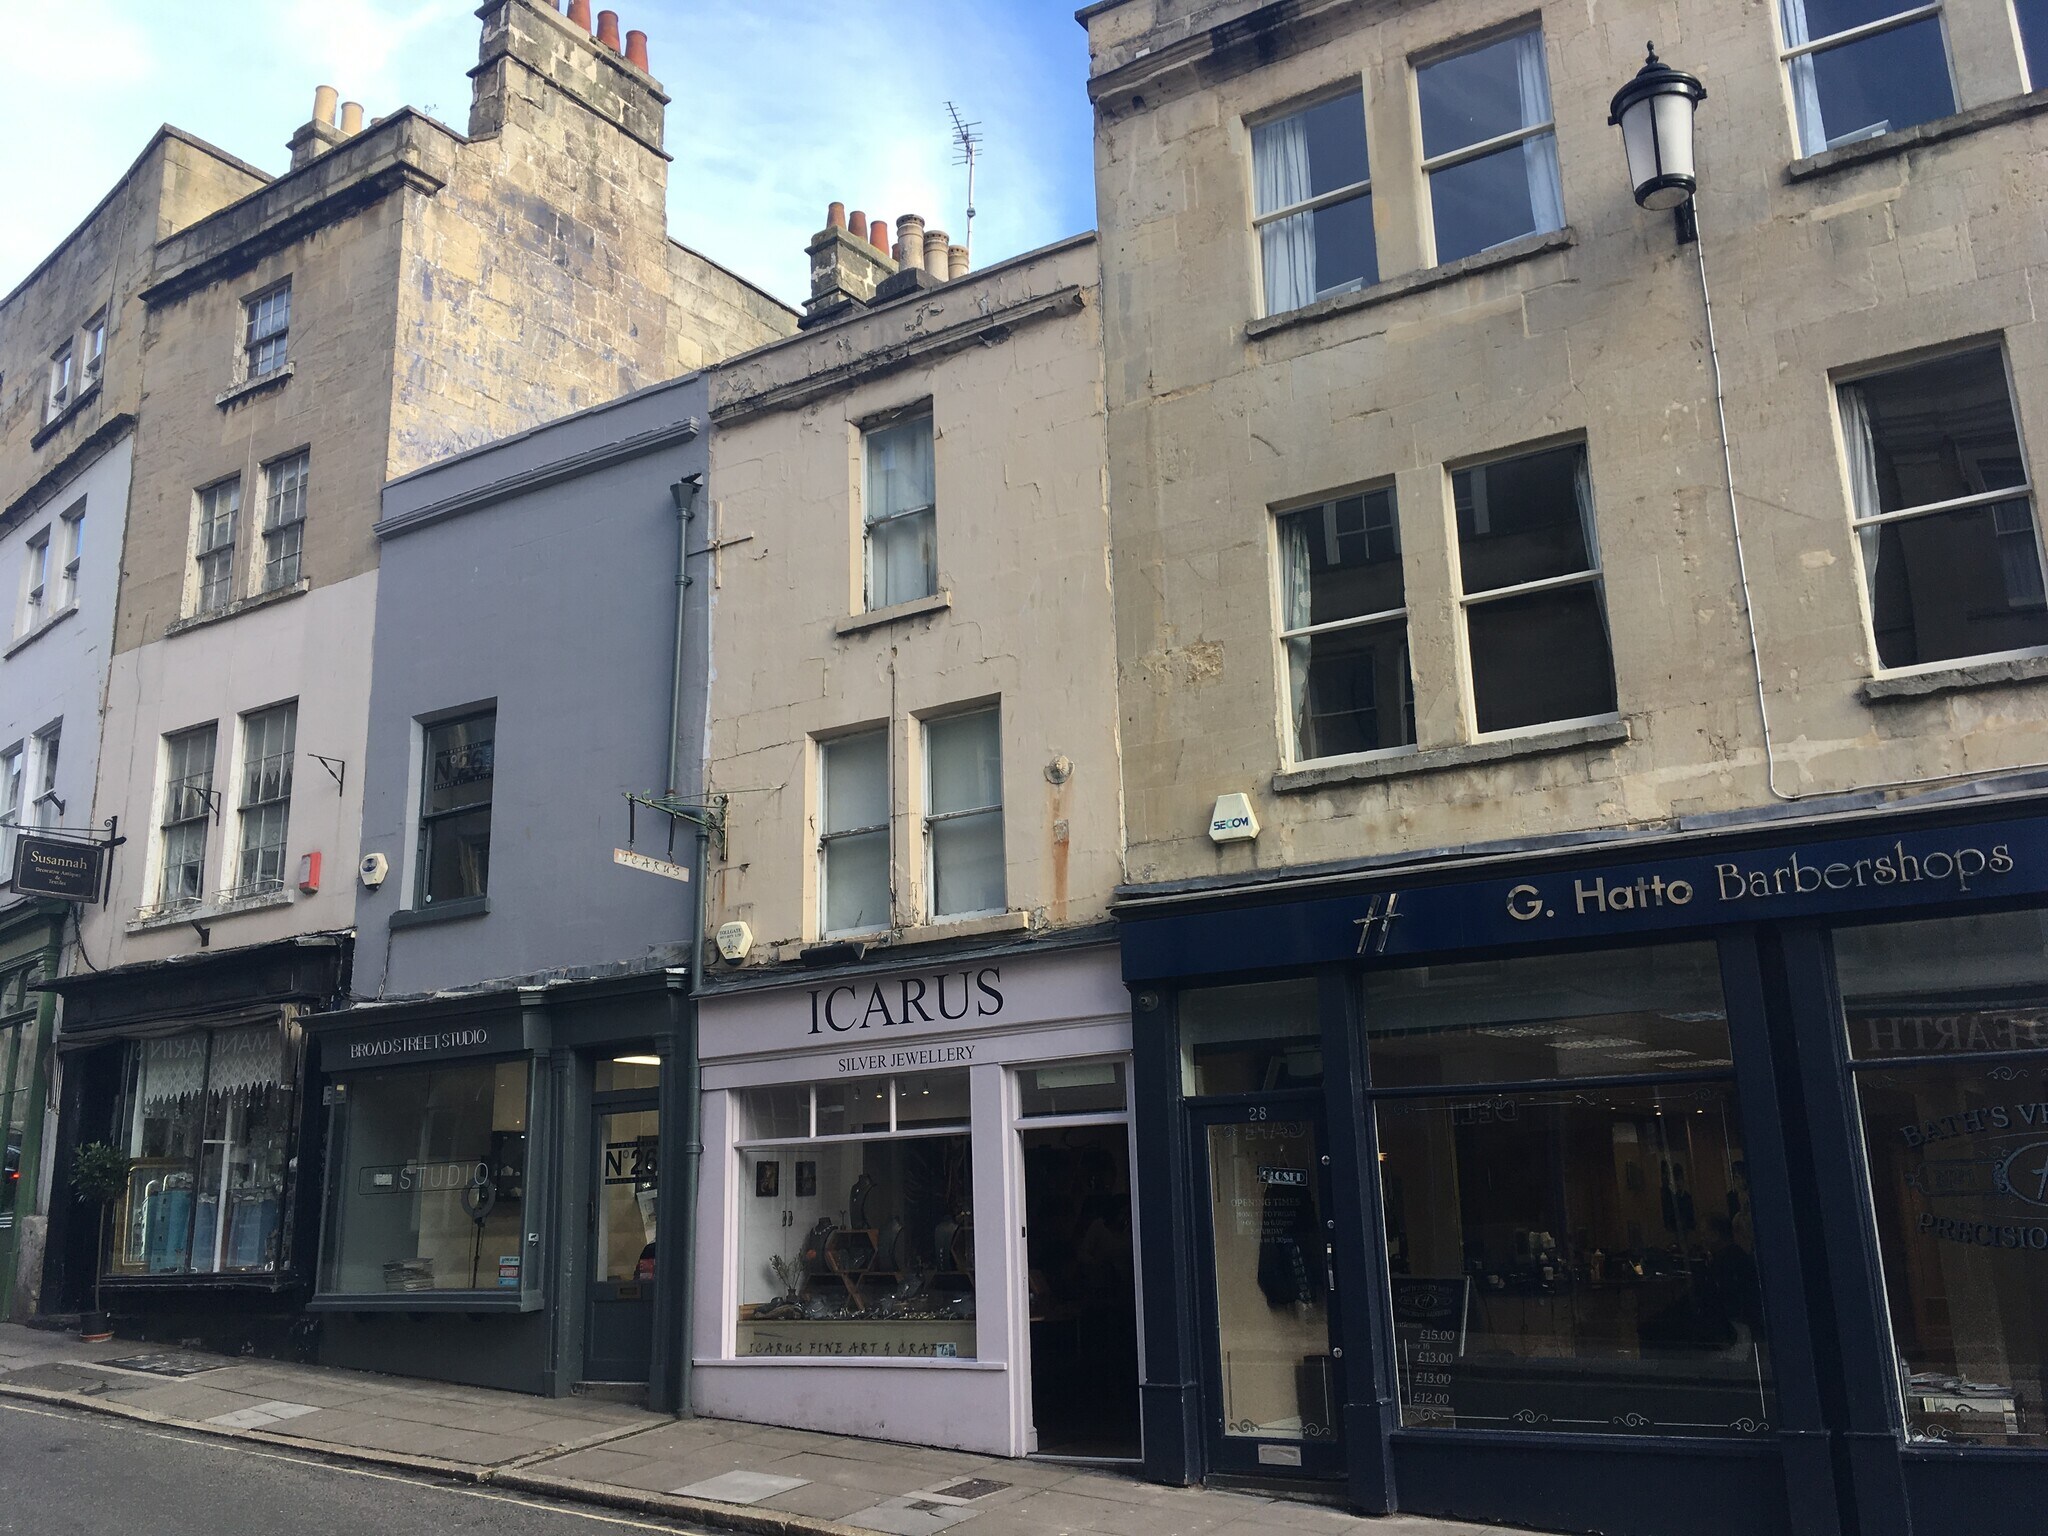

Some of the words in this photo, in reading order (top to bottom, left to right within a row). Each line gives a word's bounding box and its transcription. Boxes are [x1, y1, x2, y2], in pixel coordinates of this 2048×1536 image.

[1213, 817, 1249, 830] SECOM
[30, 850, 87, 869] Susannah
[624, 853, 680, 876] ICARUS
[1506, 884, 1555, 922] G.
[1575, 876, 1694, 916] Hatto
[1715, 841, 2014, 902] Barbershops
[807, 967, 1004, 1035] ICARUS
[350, 1041, 392, 1058] BROAD
[393, 1035, 439, 1053] STREET
[441, 1029, 487, 1048] STUDIO
[838, 1055, 887, 1072] SILVER
[890, 1045, 976, 1067] JEWELLERY
[1248, 1106, 1267, 1121] 28
[1899, 1106, 2009, 1147] BATH'S
[399, 1162, 489, 1190] STUDIO
[1262, 1170, 1305, 1182] CLOSED
[1420, 1330, 1455, 1341] £15.00
[749, 1342, 802, 1356] ICARUS
[809, 1342, 843, 1355] FINE
[849, 1342, 878, 1356] ART
[1417, 1351, 1453, 1364] £13.00
[1415, 1372, 1452, 1385] £13.00
[1413, 1392, 1450, 1405] £12.00
